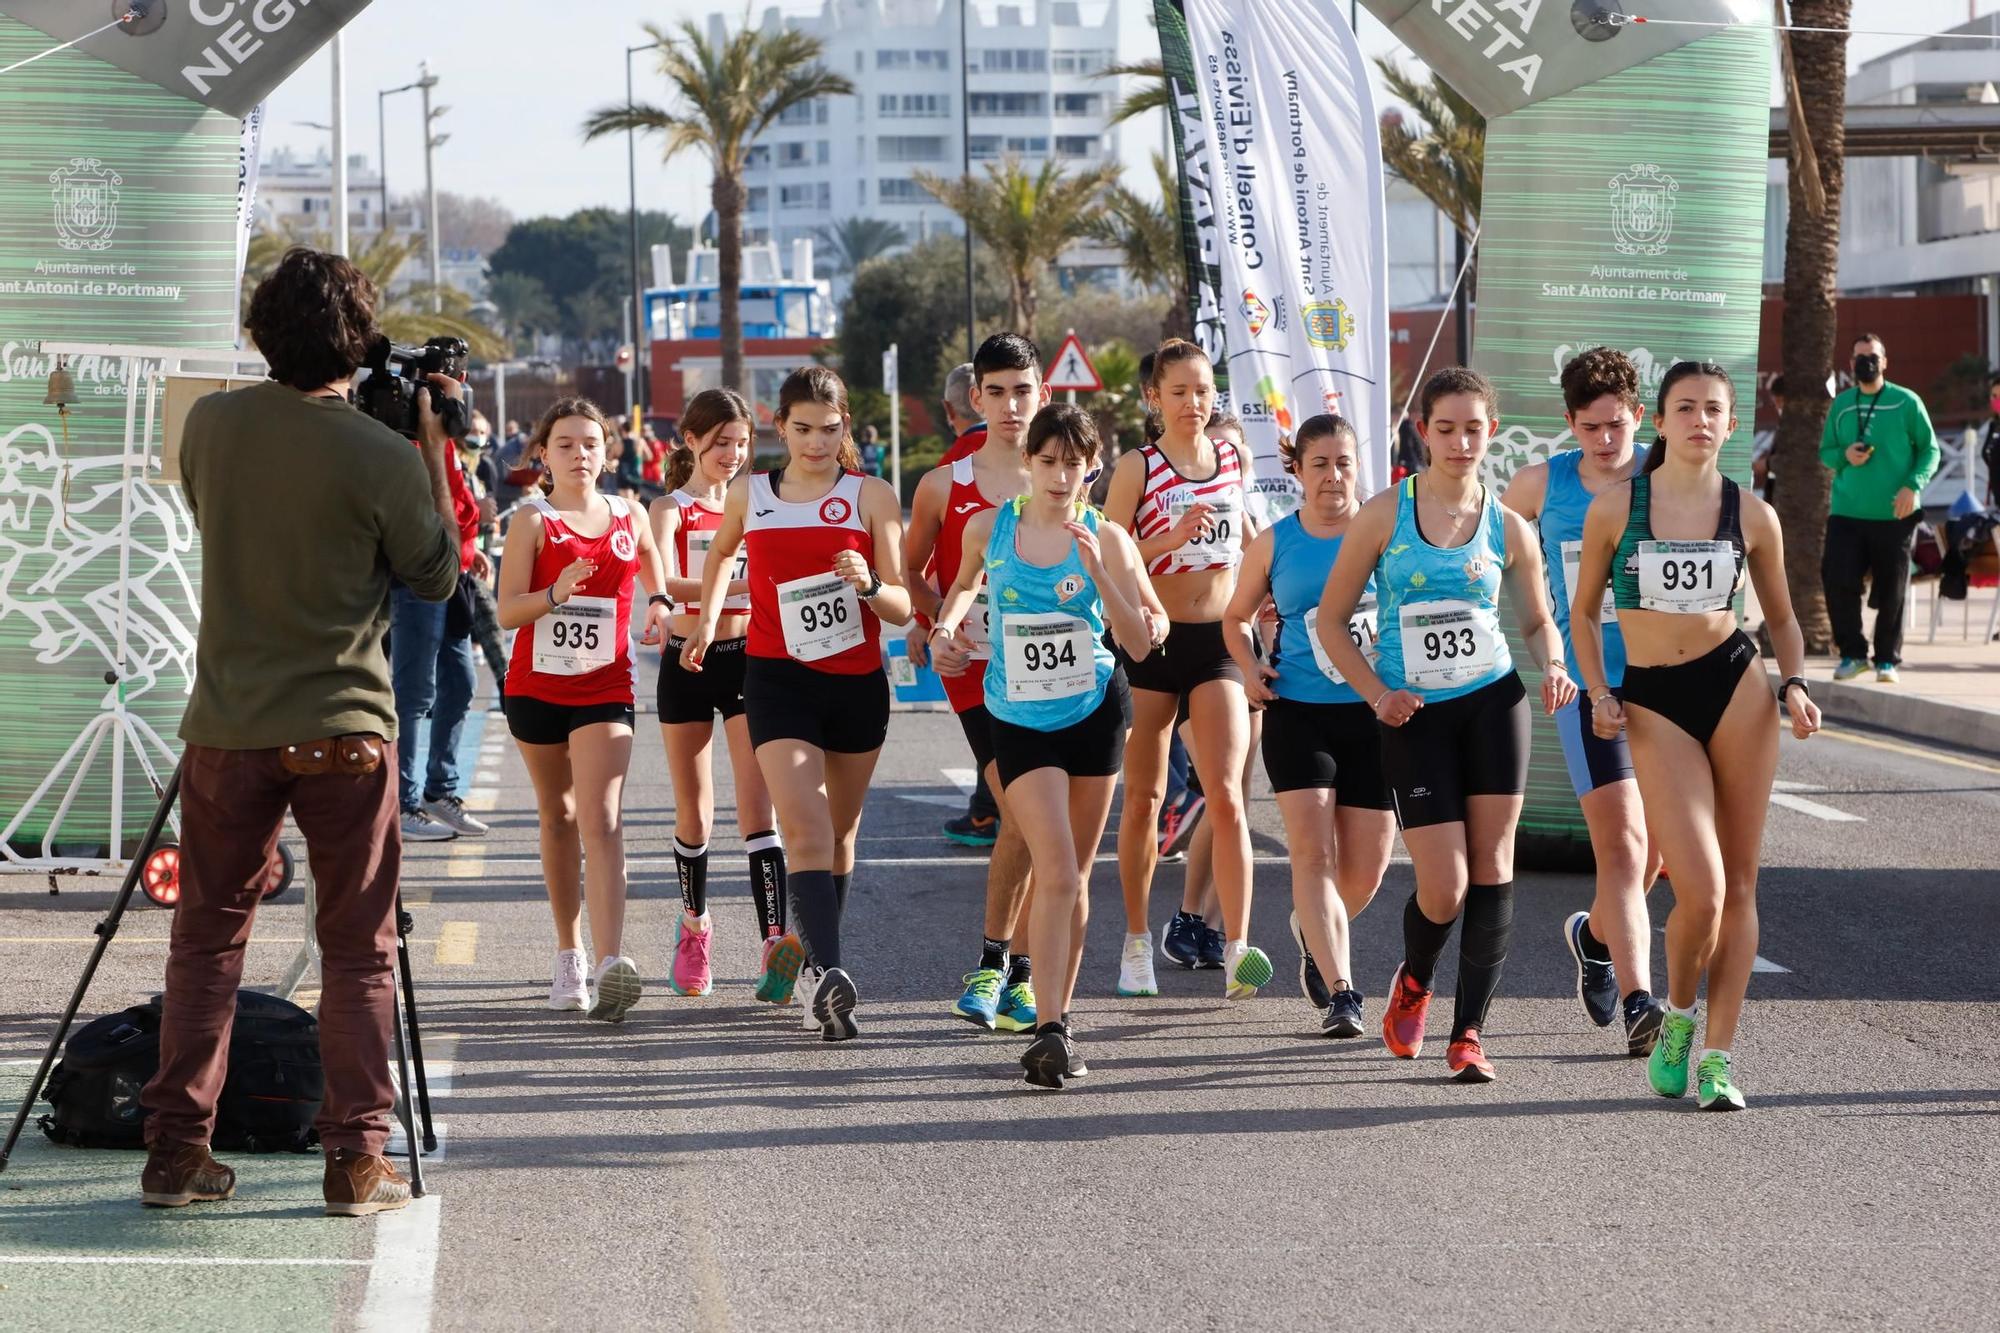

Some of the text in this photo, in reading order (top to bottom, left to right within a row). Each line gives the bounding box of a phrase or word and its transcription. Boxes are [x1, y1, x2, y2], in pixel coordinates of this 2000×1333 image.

[180, 0, 311, 96] NEG
[34, 260, 137, 276] Ajuntament de
[1590, 264, 1689, 281] Ajuntament de
[24, 280, 79, 295] Antoni
[82, 283, 104, 296] de
[107, 282, 181, 300] Portmany
[1542, 282, 1727, 306] Sant Antoni de Portmany
[1066, 582, 1074, 591] R
[1662, 560, 1712, 590] 931
[801, 597, 847, 632] 936
[553, 621, 599, 650] 935
[715, 641, 738, 652] NIKE
[1348, 618, 1373, 648] 51
[1424, 628, 1476, 661] 933
[1024, 640, 1076, 671] 934
